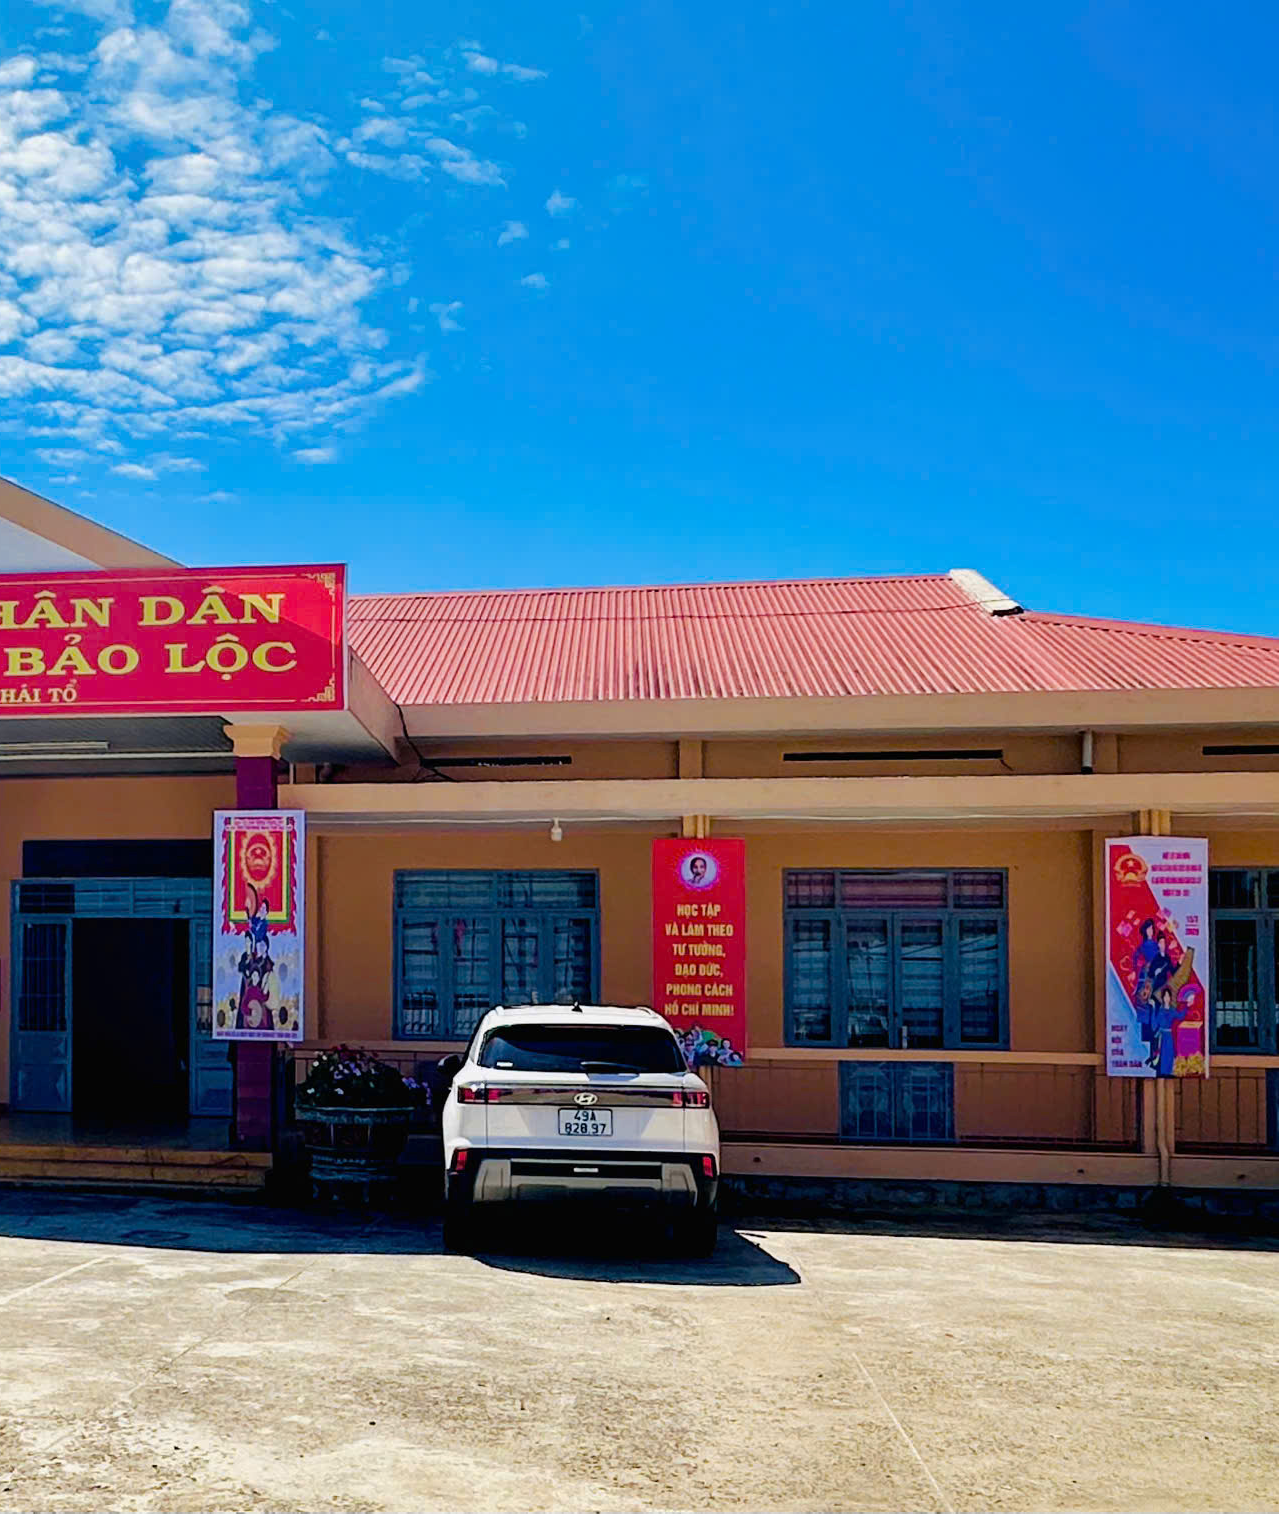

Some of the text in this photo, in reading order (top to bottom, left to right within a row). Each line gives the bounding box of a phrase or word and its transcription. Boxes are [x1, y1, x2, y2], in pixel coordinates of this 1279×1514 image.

[137, 585, 286, 626] DÂN
[3, 633, 139, 676] BẢO
[164, 633, 297, 680] LỘC
[48, 679, 77, 702] TỔ
[677, 902, 721, 919] HỌC TẬP
[665, 921, 733, 936] VÀ LÀM THEO
[672, 943, 687, 956] TƯ
[675, 963, 696, 978] ĐẠO
[666, 981, 733, 997] PHONG CÁCH
[664, 1000, 679, 1015] HỒ
[681, 1001, 699, 1016] CHÍ
[574, 1110, 596, 1121] 49A
